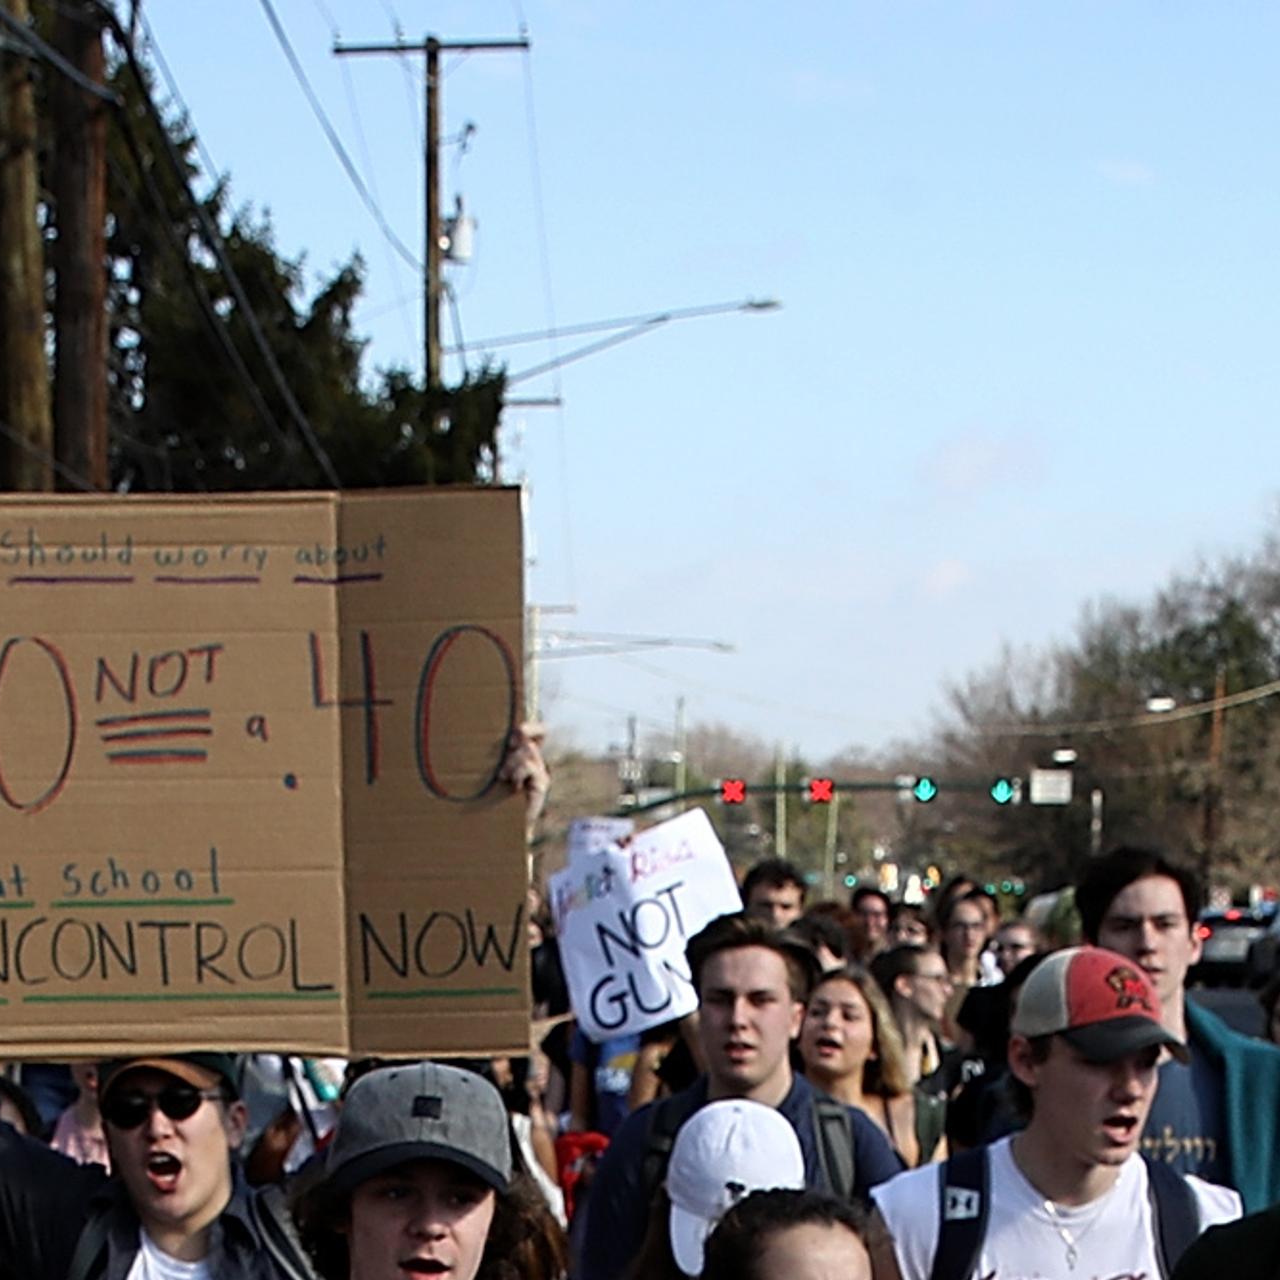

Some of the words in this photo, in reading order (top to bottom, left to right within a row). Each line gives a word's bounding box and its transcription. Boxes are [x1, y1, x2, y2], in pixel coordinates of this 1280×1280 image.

[154, 544, 269, 570] worry
[294, 534, 387, 564] about
[96, 641, 224, 703] NOT
[246, 714, 269, 743] a
[359, 903, 524, 985] NOW
[595, 881, 685, 967] NOT
